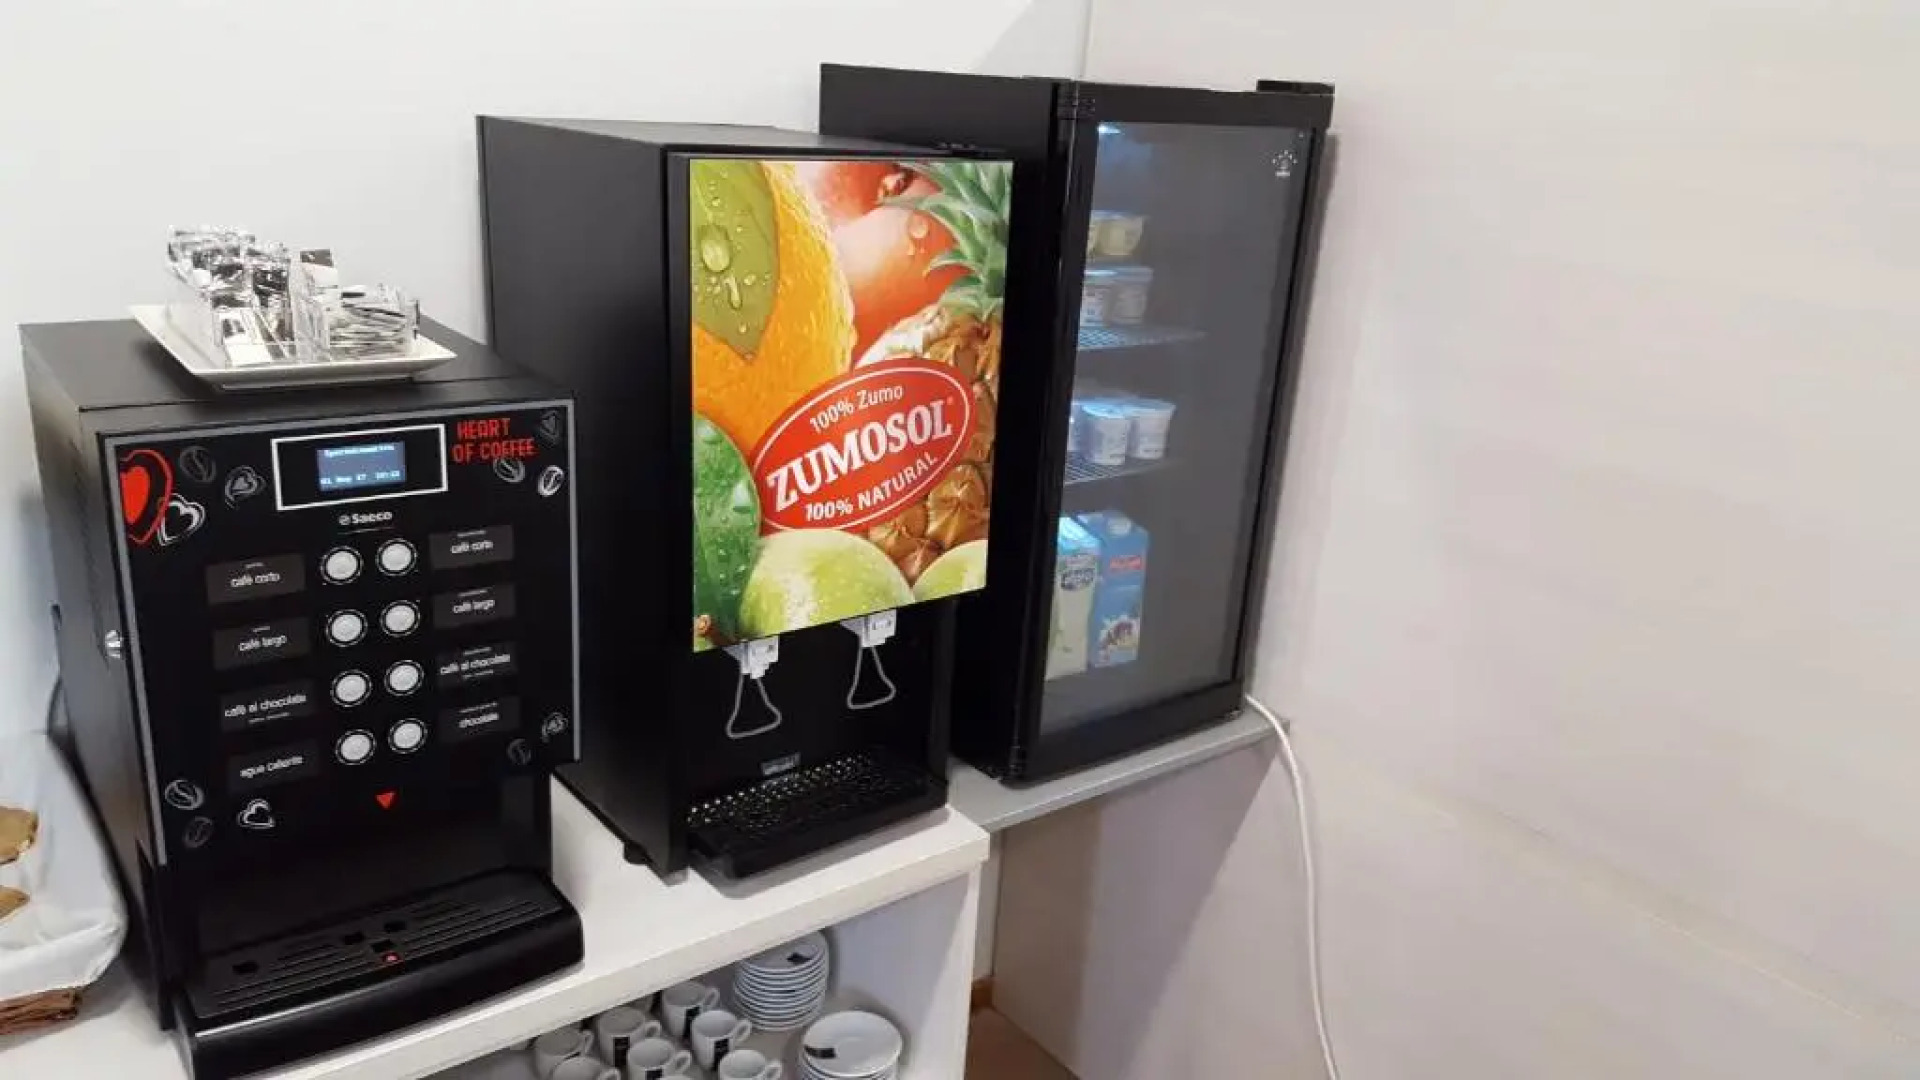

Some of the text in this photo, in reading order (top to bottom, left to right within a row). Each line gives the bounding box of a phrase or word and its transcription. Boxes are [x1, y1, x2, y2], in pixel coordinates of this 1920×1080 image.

[456, 417, 511, 440] HEART
[809, 384, 904, 435] 100% Zumo
[452, 437, 537, 463] OF COFFEE
[766, 398, 953, 513] ZUMOSOL
[804, 451, 939, 522] 100% NATURAL
[351, 511, 393, 524] Saeco
